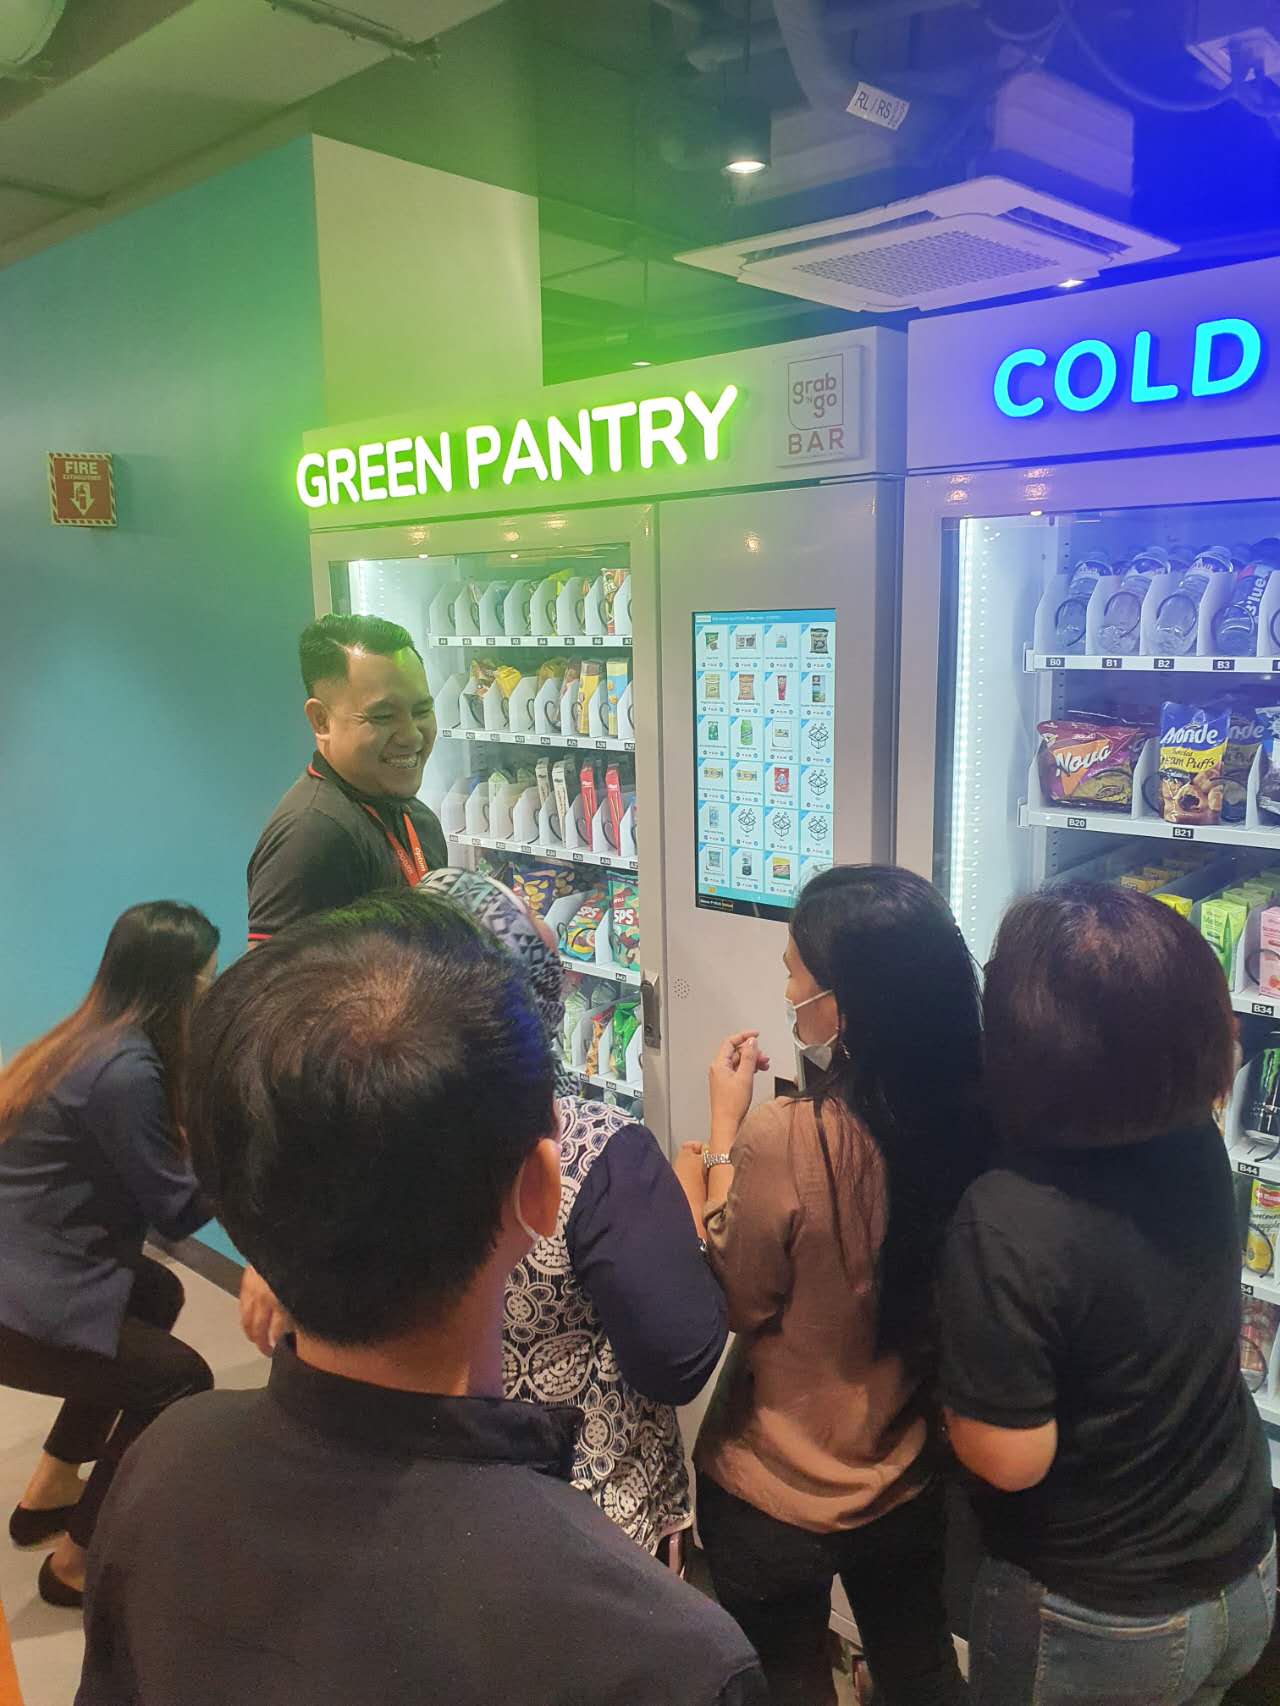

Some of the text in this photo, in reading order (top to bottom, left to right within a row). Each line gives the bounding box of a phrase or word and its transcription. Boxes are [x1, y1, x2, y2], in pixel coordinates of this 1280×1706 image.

[994, 318, 1261, 417] COLD
[792, 372, 837, 404] grab
[813, 392, 838, 419] go
[296, 384, 738, 508] GREEN PANTRY
[788, 427, 845, 455] BAR
[64, 461, 99, 475] FIRE
[1050, 658, 1230, 669] B0 B1 B2 B3
[1160, 723, 1218, 744] Monde
[1186, 757, 1216, 769] Puffs
[1069, 818, 1086, 828] B20
[1174, 829, 1192, 838] B21
[1253, 1004, 1272, 1015] B34
[1240, 1163, 1258, 1176] B44
